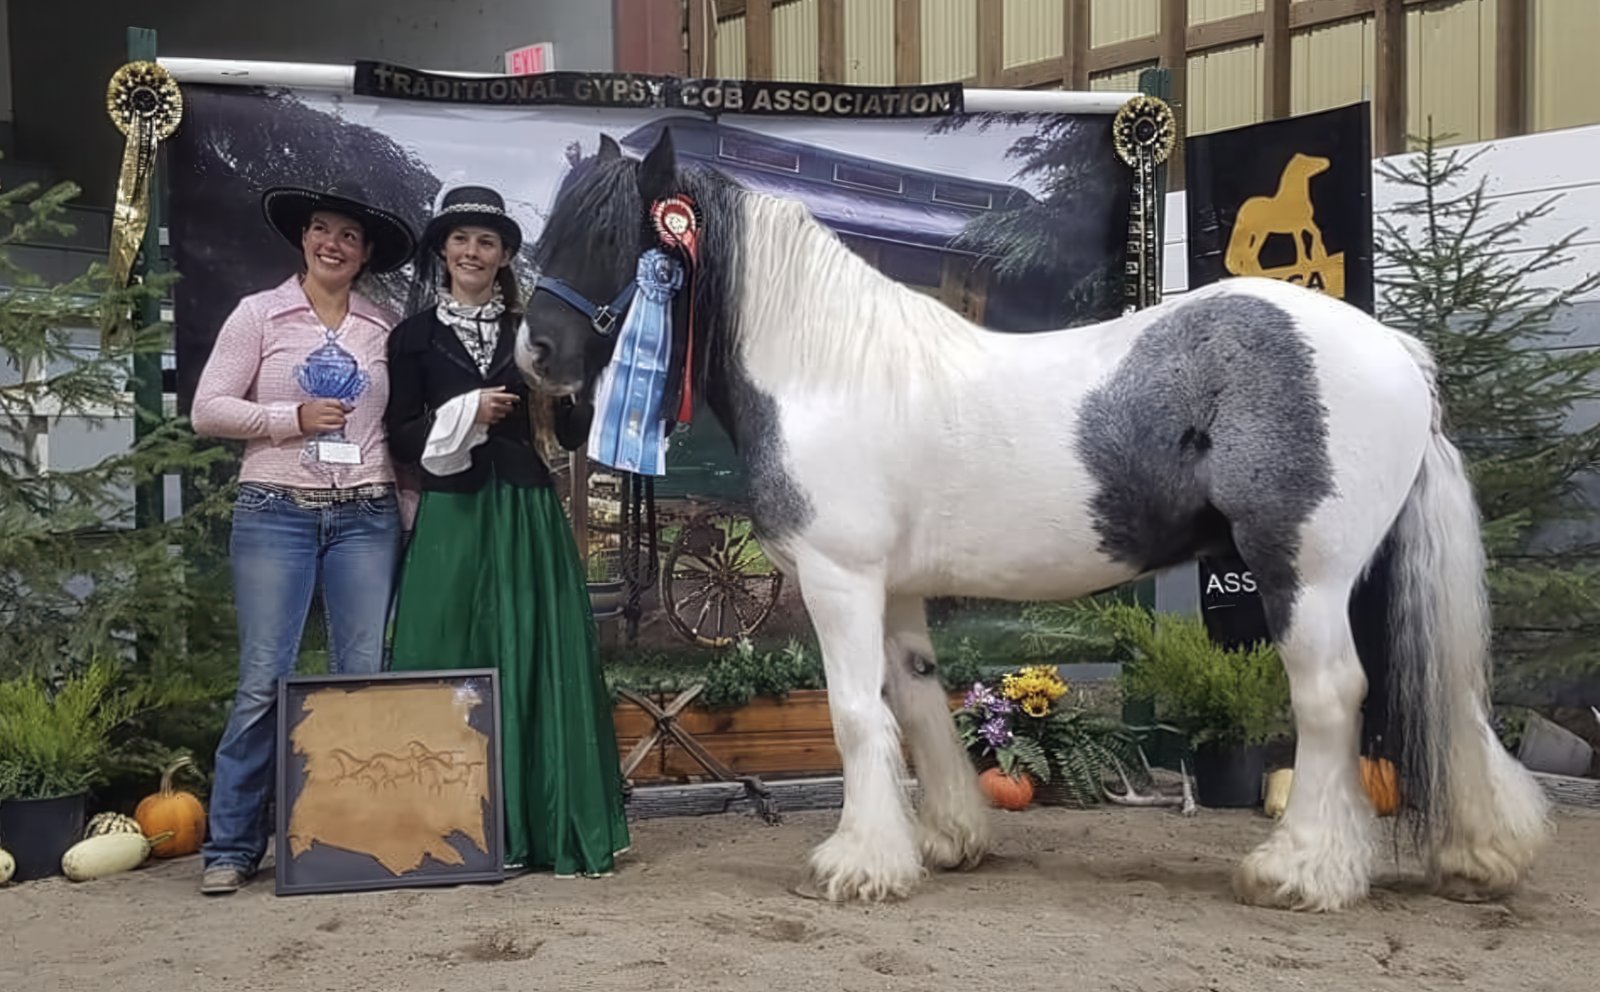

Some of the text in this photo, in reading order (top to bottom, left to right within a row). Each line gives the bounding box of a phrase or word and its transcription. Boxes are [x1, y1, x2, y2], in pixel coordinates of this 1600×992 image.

[512, 47, 543, 74] EXIT
[373, 68, 951, 114] TRADITIONAL GYPSY COB ASSOCIATION
